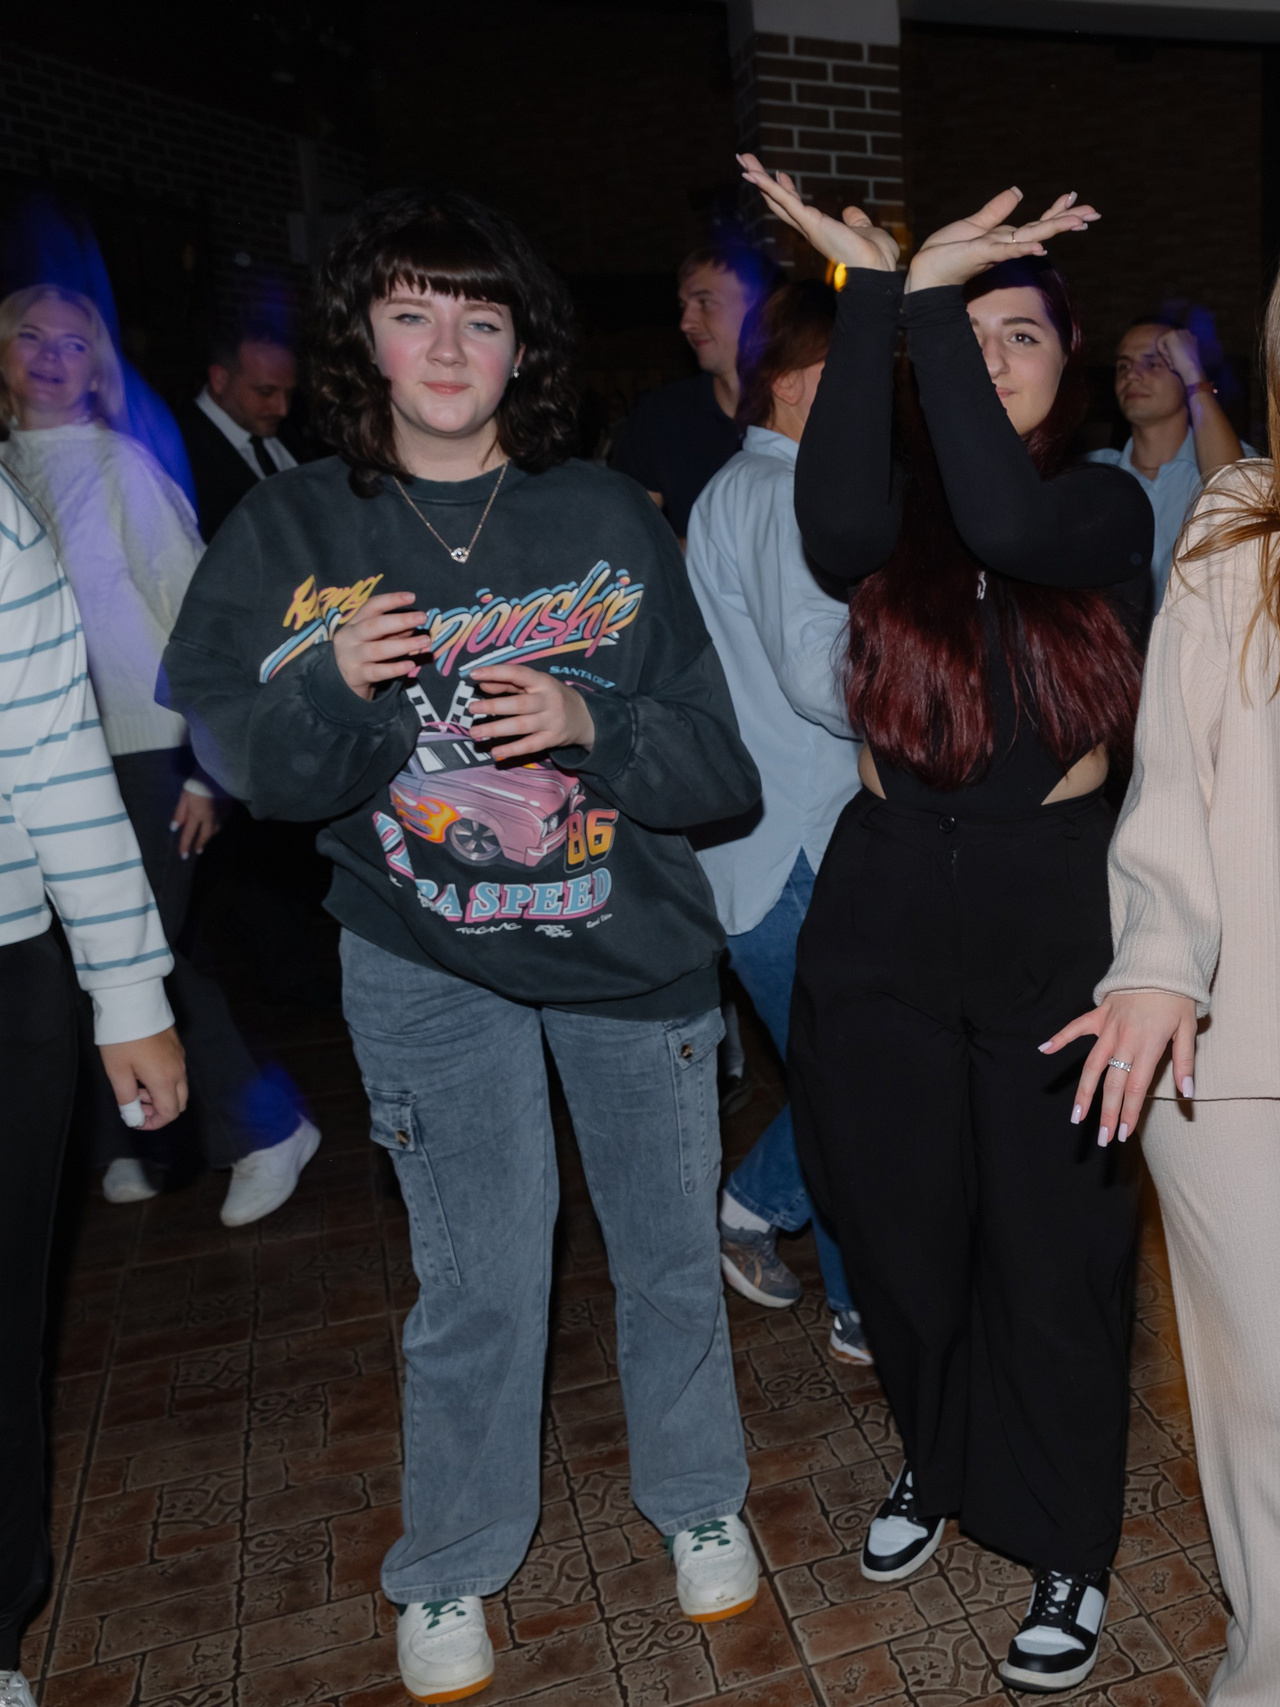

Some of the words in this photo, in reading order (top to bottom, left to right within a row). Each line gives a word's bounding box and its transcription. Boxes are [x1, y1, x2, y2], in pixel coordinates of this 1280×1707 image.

[549, 665, 592, 680] SANTA
[565, 809, 619, 870] 86
[466, 867, 612, 922] SPEED
